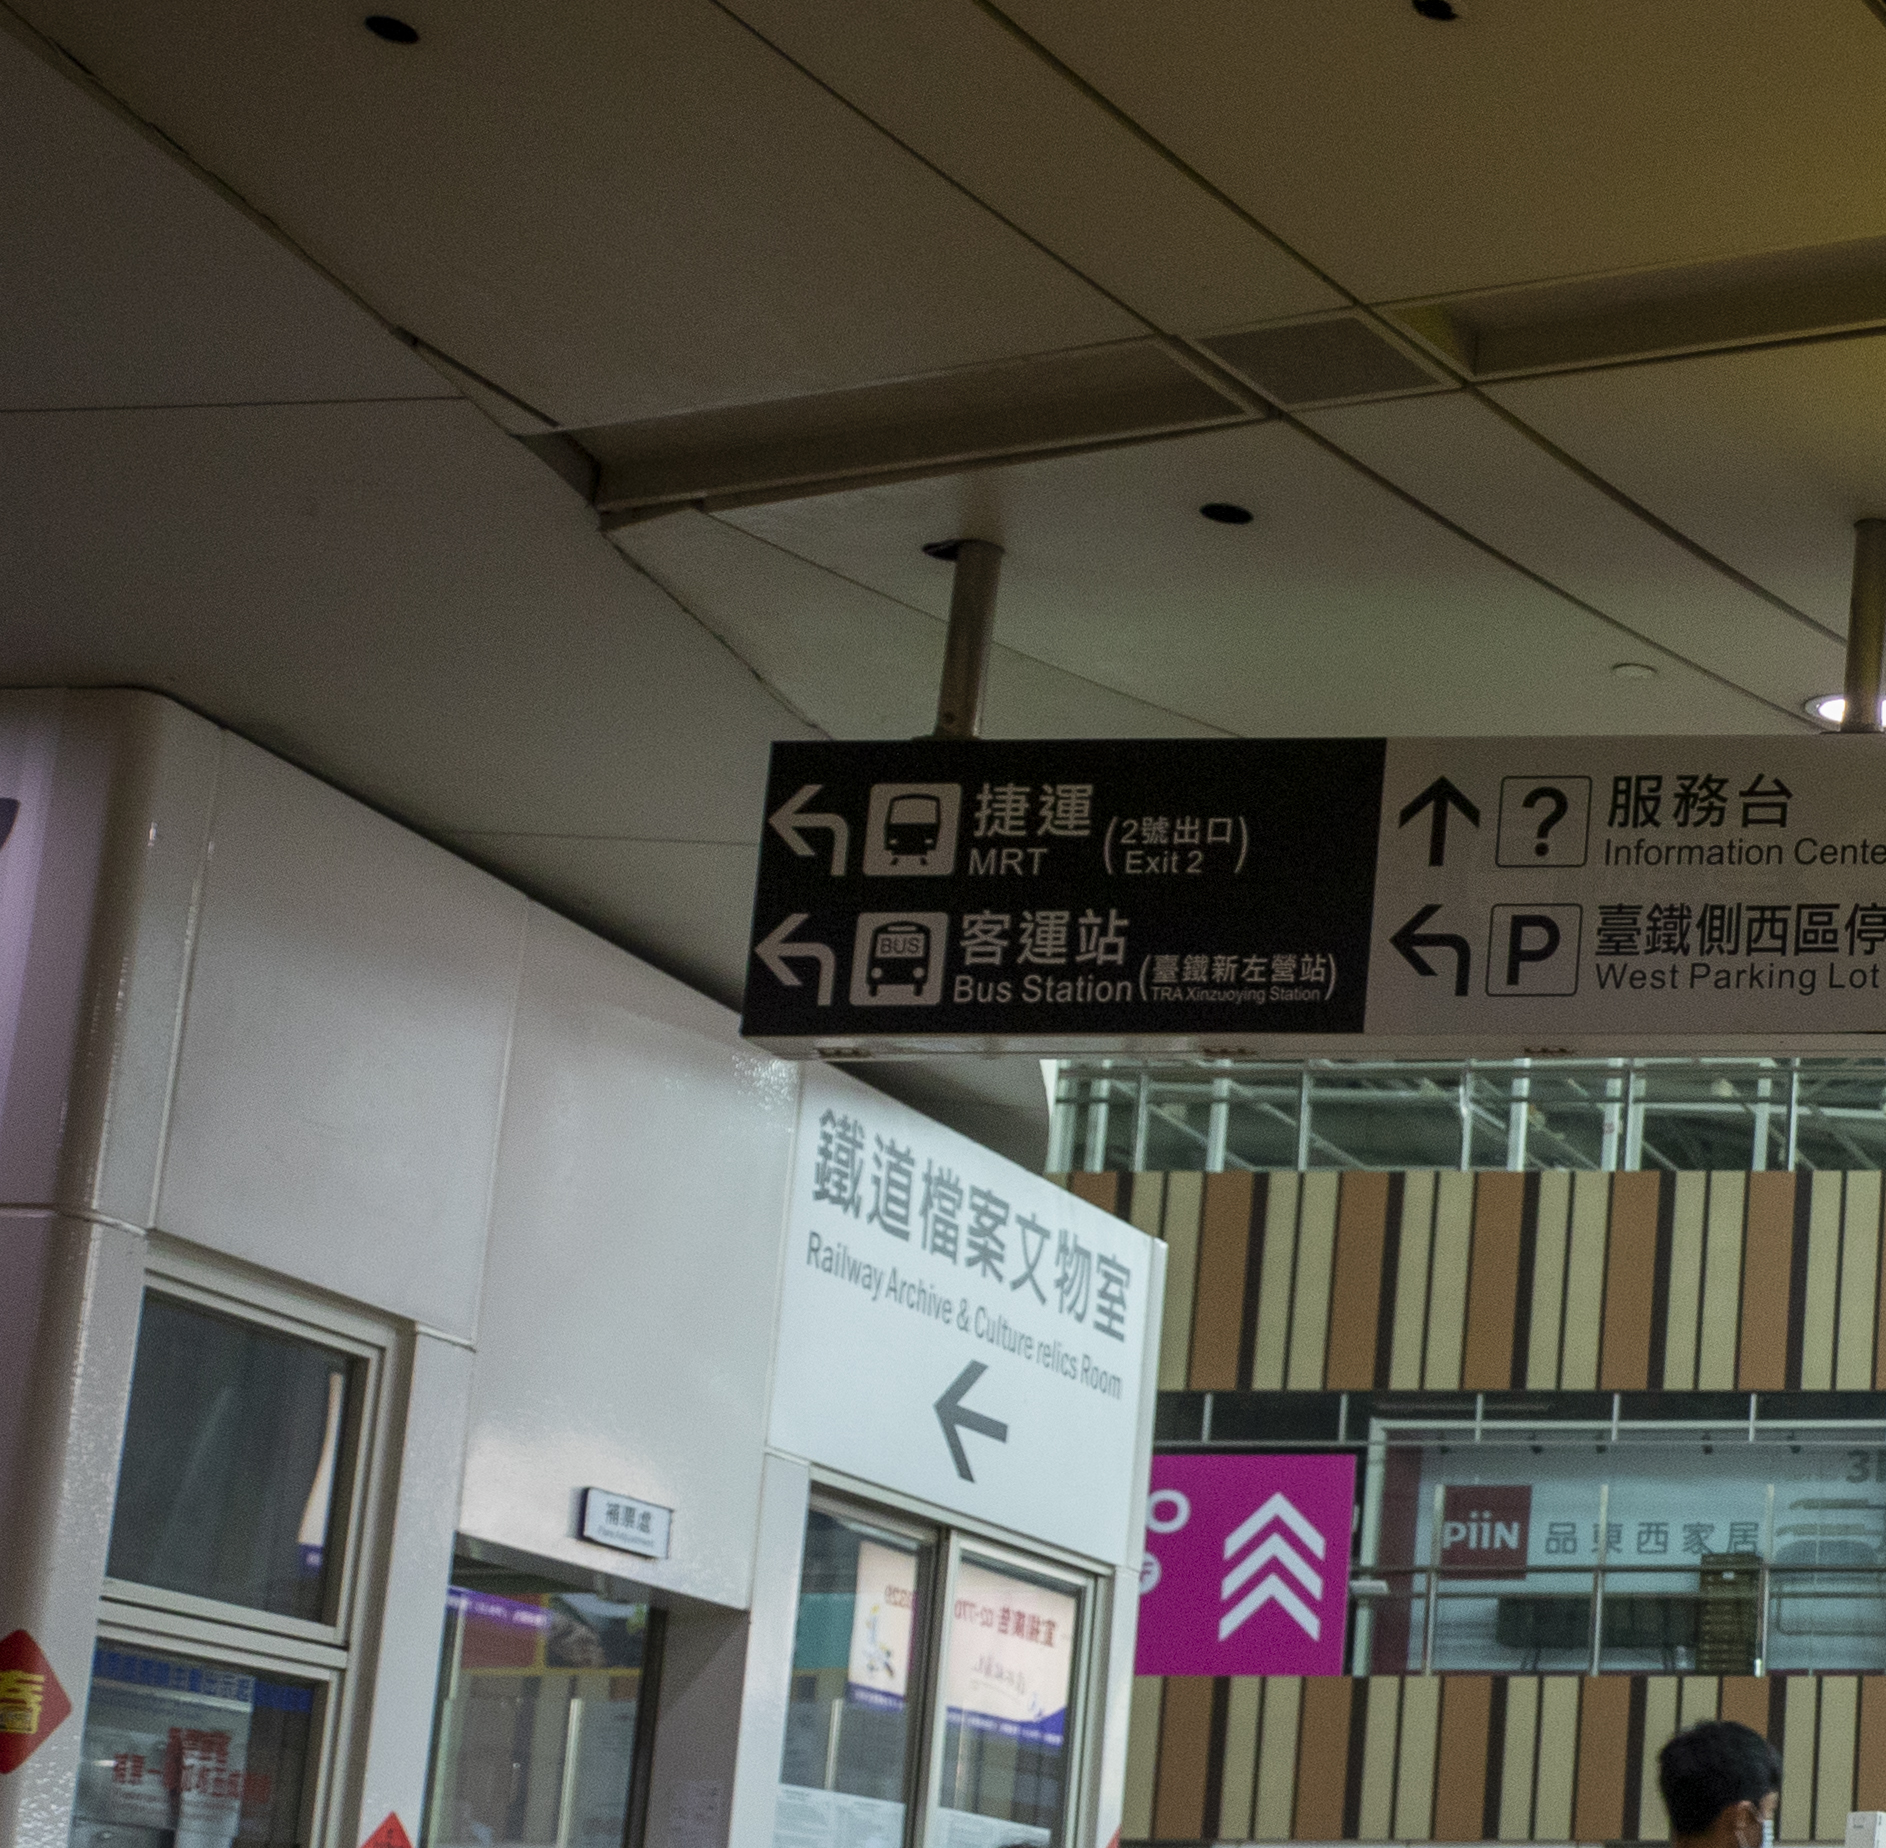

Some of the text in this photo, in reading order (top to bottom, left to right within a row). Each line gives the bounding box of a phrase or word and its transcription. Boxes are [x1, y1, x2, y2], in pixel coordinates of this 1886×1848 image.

[973, 783, 1093, 837] 捷運
[1608, 773, 1793, 830] 服務台
[967, 848, 1048, 876] MRT
[1125, 850, 1203, 874] Exit 2
[1604, 837, 1785, 867] Information
[880, 935, 921, 955] BUS
[959, 909, 1131, 967] 客運站
[953, 973, 1133, 1004] Bus Station
[1596, 962, 1880, 996] West Parking Lot
[1152, 987, 1321, 1004] TRA Xinzuoying Station
[813, 1108, 1132, 1342] 鐵道檔案文物室
[807, 1231, 1123, 1401] Railway Archive & Culture relics Room
